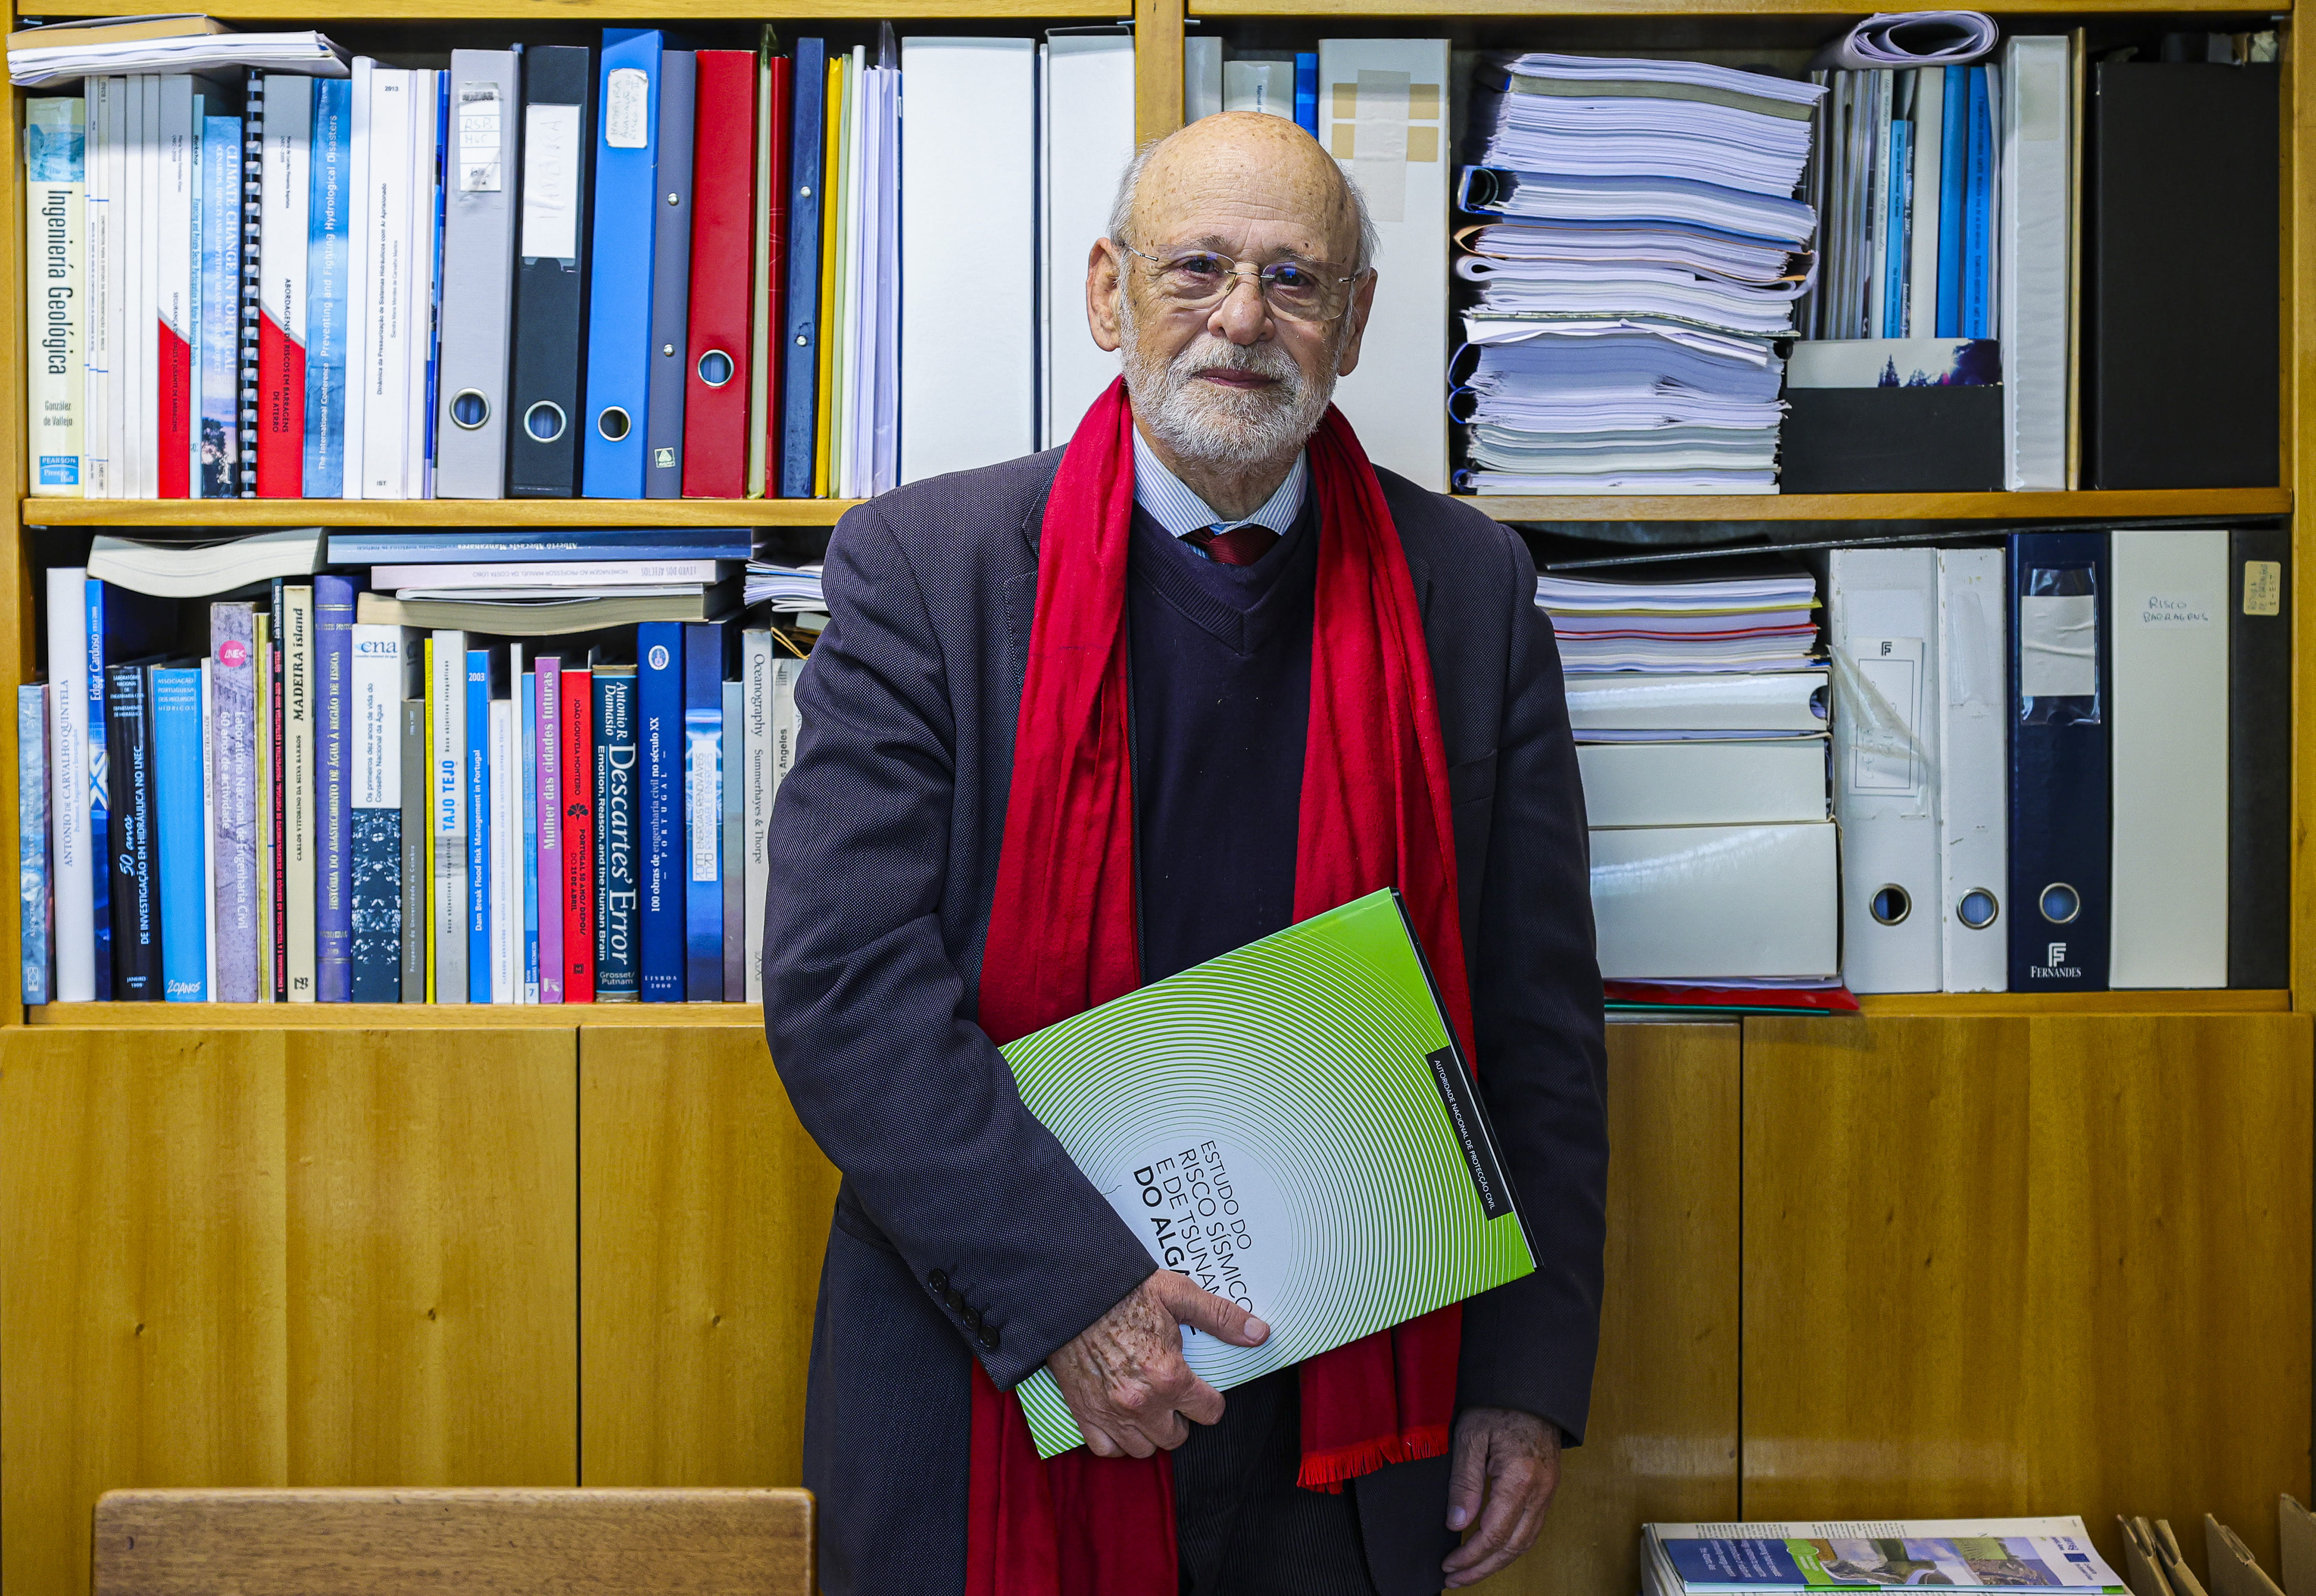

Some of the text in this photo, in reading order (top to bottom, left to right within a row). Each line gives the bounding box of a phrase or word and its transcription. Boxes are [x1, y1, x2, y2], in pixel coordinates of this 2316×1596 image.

[327, 115, 338, 162] Disasters
[324, 167, 338, 230] Hydrological
[42, 191, 73, 278] Ingeniería
[323, 234, 334, 274] Fighting
[224, 145, 237, 372] CLIMATE CHANGE IN PORTUGAL
[322, 279, 332, 297] and
[42, 287, 74, 374] Geológica
[321, 302, 333, 356] Preventing
[273, 391, 279, 401] DE
[283, 374, 289, 385] EM
[320, 363, 329, 404] Conference
[44, 416, 73, 427] de Vallejo
[45, 401, 71, 410] González
[318, 406, 328, 453] International
[666, 566, 677, 575] DOS
[293, 608, 303, 647] island
[89, 634, 105, 700] Edgar Cardoso
[329, 651, 339, 681] LISBOA
[468, 672, 485, 682] 2003
[293, 652, 304, 722] MADEIRA
[329, 683, 340, 695] DE
[366, 683, 373, 692] do
[750, 654, 765, 736] Oceanography
[60, 680, 72, 737] QUINTELA
[328, 699, 340, 730] REGIÃO
[366, 712, 372, 721] de
[374, 704, 383, 723] Água
[574, 699, 582, 719] JOÃO
[604, 684, 615, 735] Damasio
[616, 682, 628, 741] Antonio R.
[375, 725, 382, 733] da
[779, 729, 788, 768] Angeles
[61, 740, 71, 799] CARVALHO
[220, 711, 231, 830] 60 anos de actividade
[328, 742, 340, 767] ÁGUA
[472, 749, 482, 783] Portugal
[542, 671, 555, 849] Mulher das cidades futuras
[704, 753, 712, 794] ENERGIES
[296, 786, 301, 795] DA
[329, 770, 339, 781] DE
[695, 753, 704, 806] RENOVÁVEIS
[752, 749, 764, 815] Summerhayes
[366, 792, 373, 802] Os
[442, 761, 455, 831] TAJO TEJO
[649, 717, 661, 912] 100 obras de engenharia civil no século XX
[233, 712, 248, 929] Laboratório Nacional de Engenharia Civil
[473, 794, 483, 845] Management
[597, 798, 605, 842] Reason,
[696, 808, 704, 849] ENERGIAS
[62, 814, 72, 867] ANTÓNIO
[119, 814, 135, 876] 50 anos
[133, 745, 150, 945] DE INVESTIGAÇÃO EM HIDRÁULICA NO LNEC
[571, 852, 577, 864] DO
[608, 743, 637, 965] Descartes’ Error
[751, 830, 763, 864] Thorpe
[329, 855, 339, 868] DO
[474, 865, 482, 887] Flood
[570, 876, 577, 886] DE
[579, 873, 585, 882] 50
[327, 871, 340, 910] HISTÓRIA
[2030, 965, 2082, 978] FERNANDES
[529, 988, 535, 996] 7
[1434, 1060, 1496, 1210] AUTORIDADE NACIONAL DE PROTECÇÃO CIVIL
[1156, 1157, 1175, 1174] E
[1133, 1165, 1162, 1207] DO
[1163, 1176, 1189, 1210] DE
[1201, 1140, 1252, 1249] ESTUDO DO
[1178, 1149, 1253, 1313] RISCO SÍSMICO
